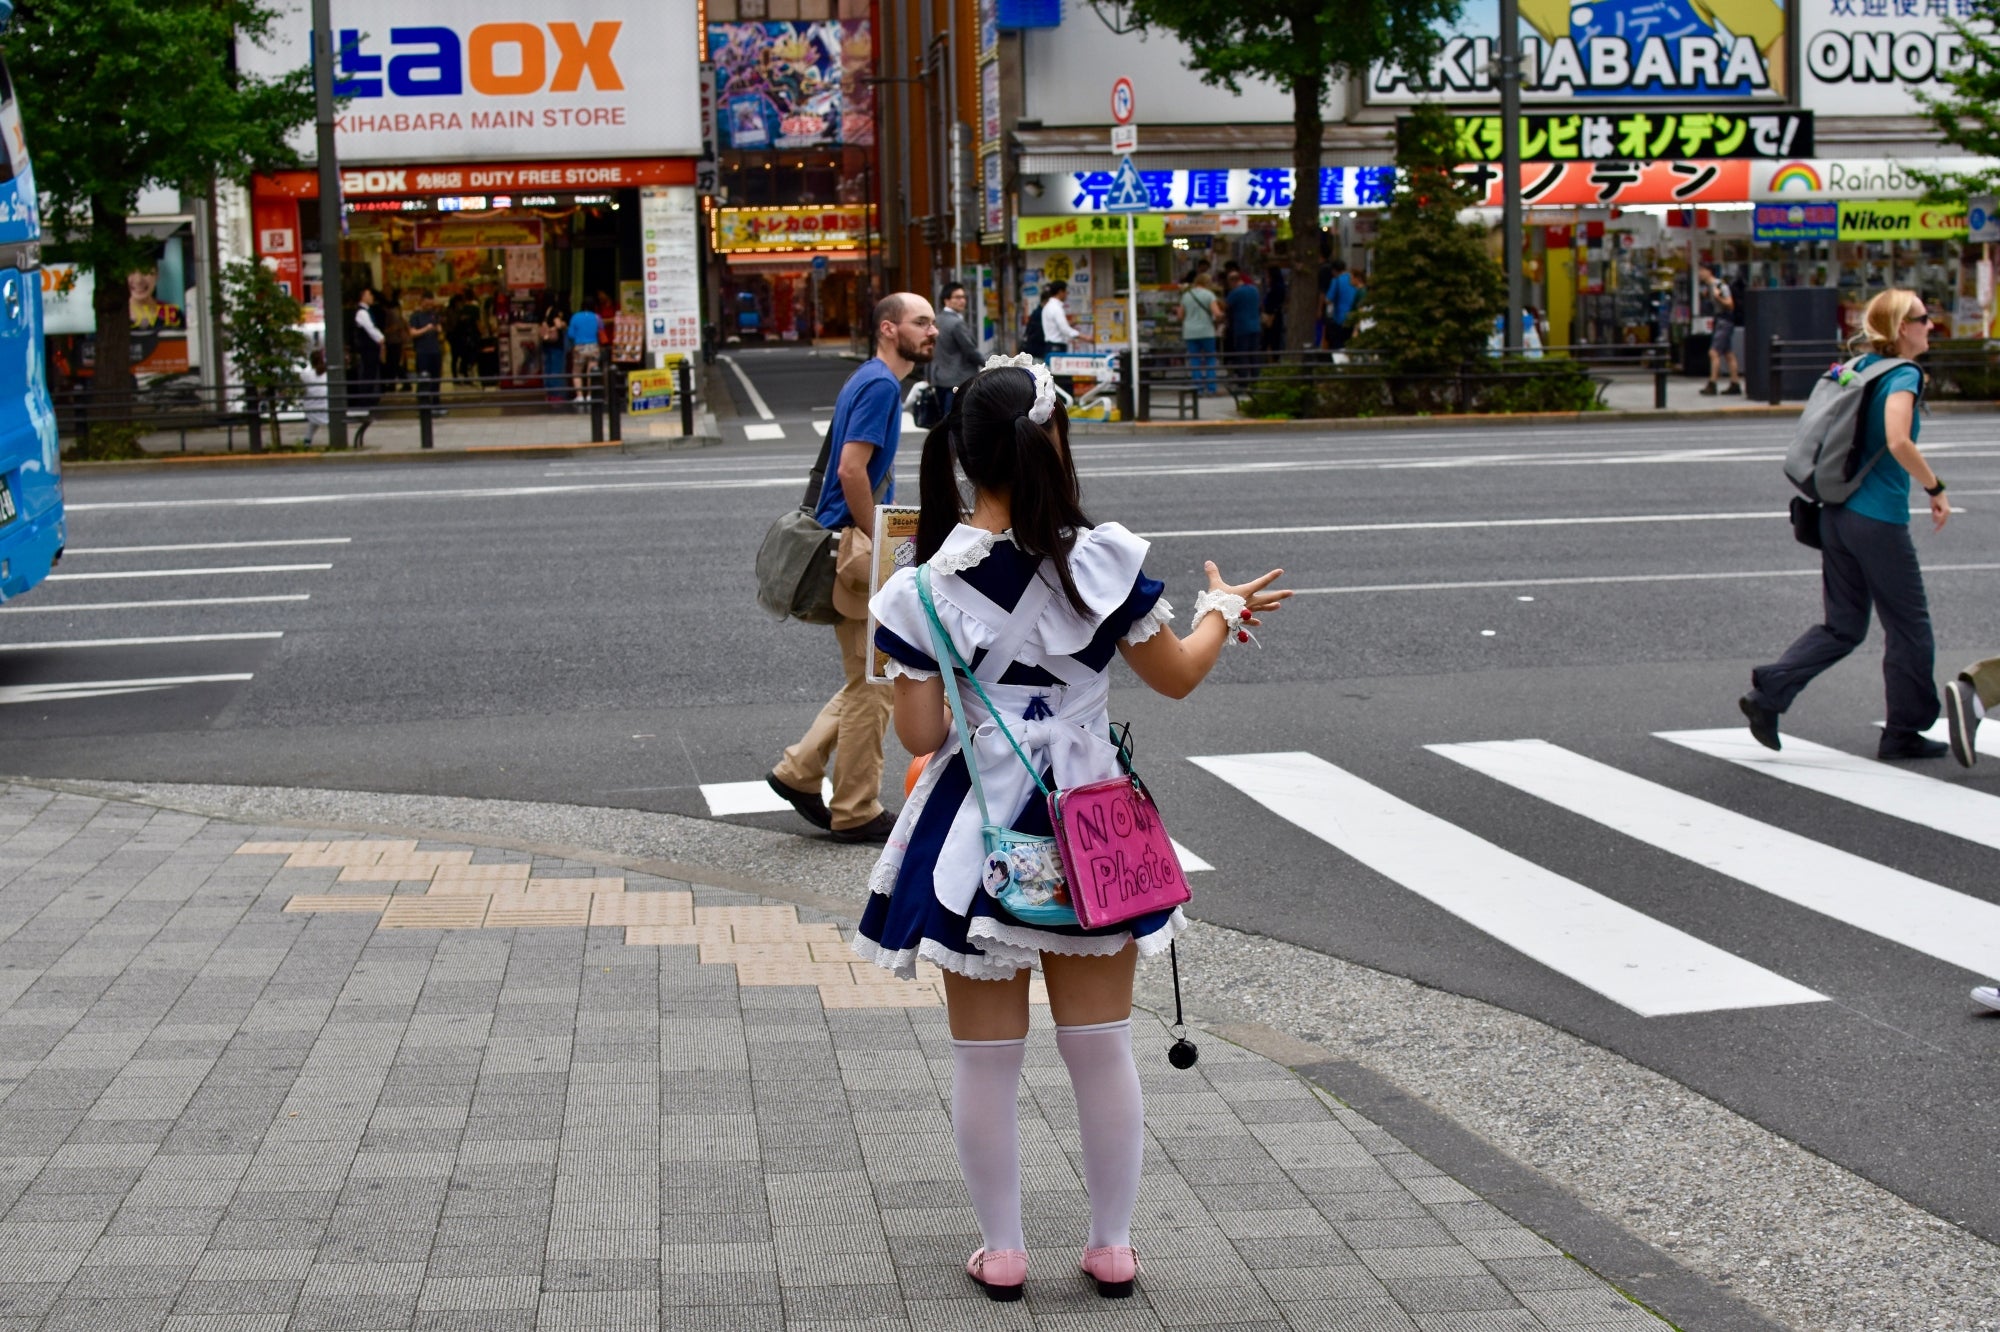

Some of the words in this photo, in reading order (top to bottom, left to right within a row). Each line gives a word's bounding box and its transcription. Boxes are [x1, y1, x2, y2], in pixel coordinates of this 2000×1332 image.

[333, 112, 463, 134] KIHABARA
[471, 110, 534, 129] MAIN
[543, 107, 626, 127] STORE
[342, 170, 407, 193] aox
[470, 171, 515, 187] DUTY
[519, 169, 562, 185] FREE
[566, 167, 622, 184] STORE
[1829, 162, 1918, 191] Rainbo
[1842, 210, 1911, 231] Nikon
[1920, 211, 1969, 230] Can
[1090, 843, 1175, 909] Photo
